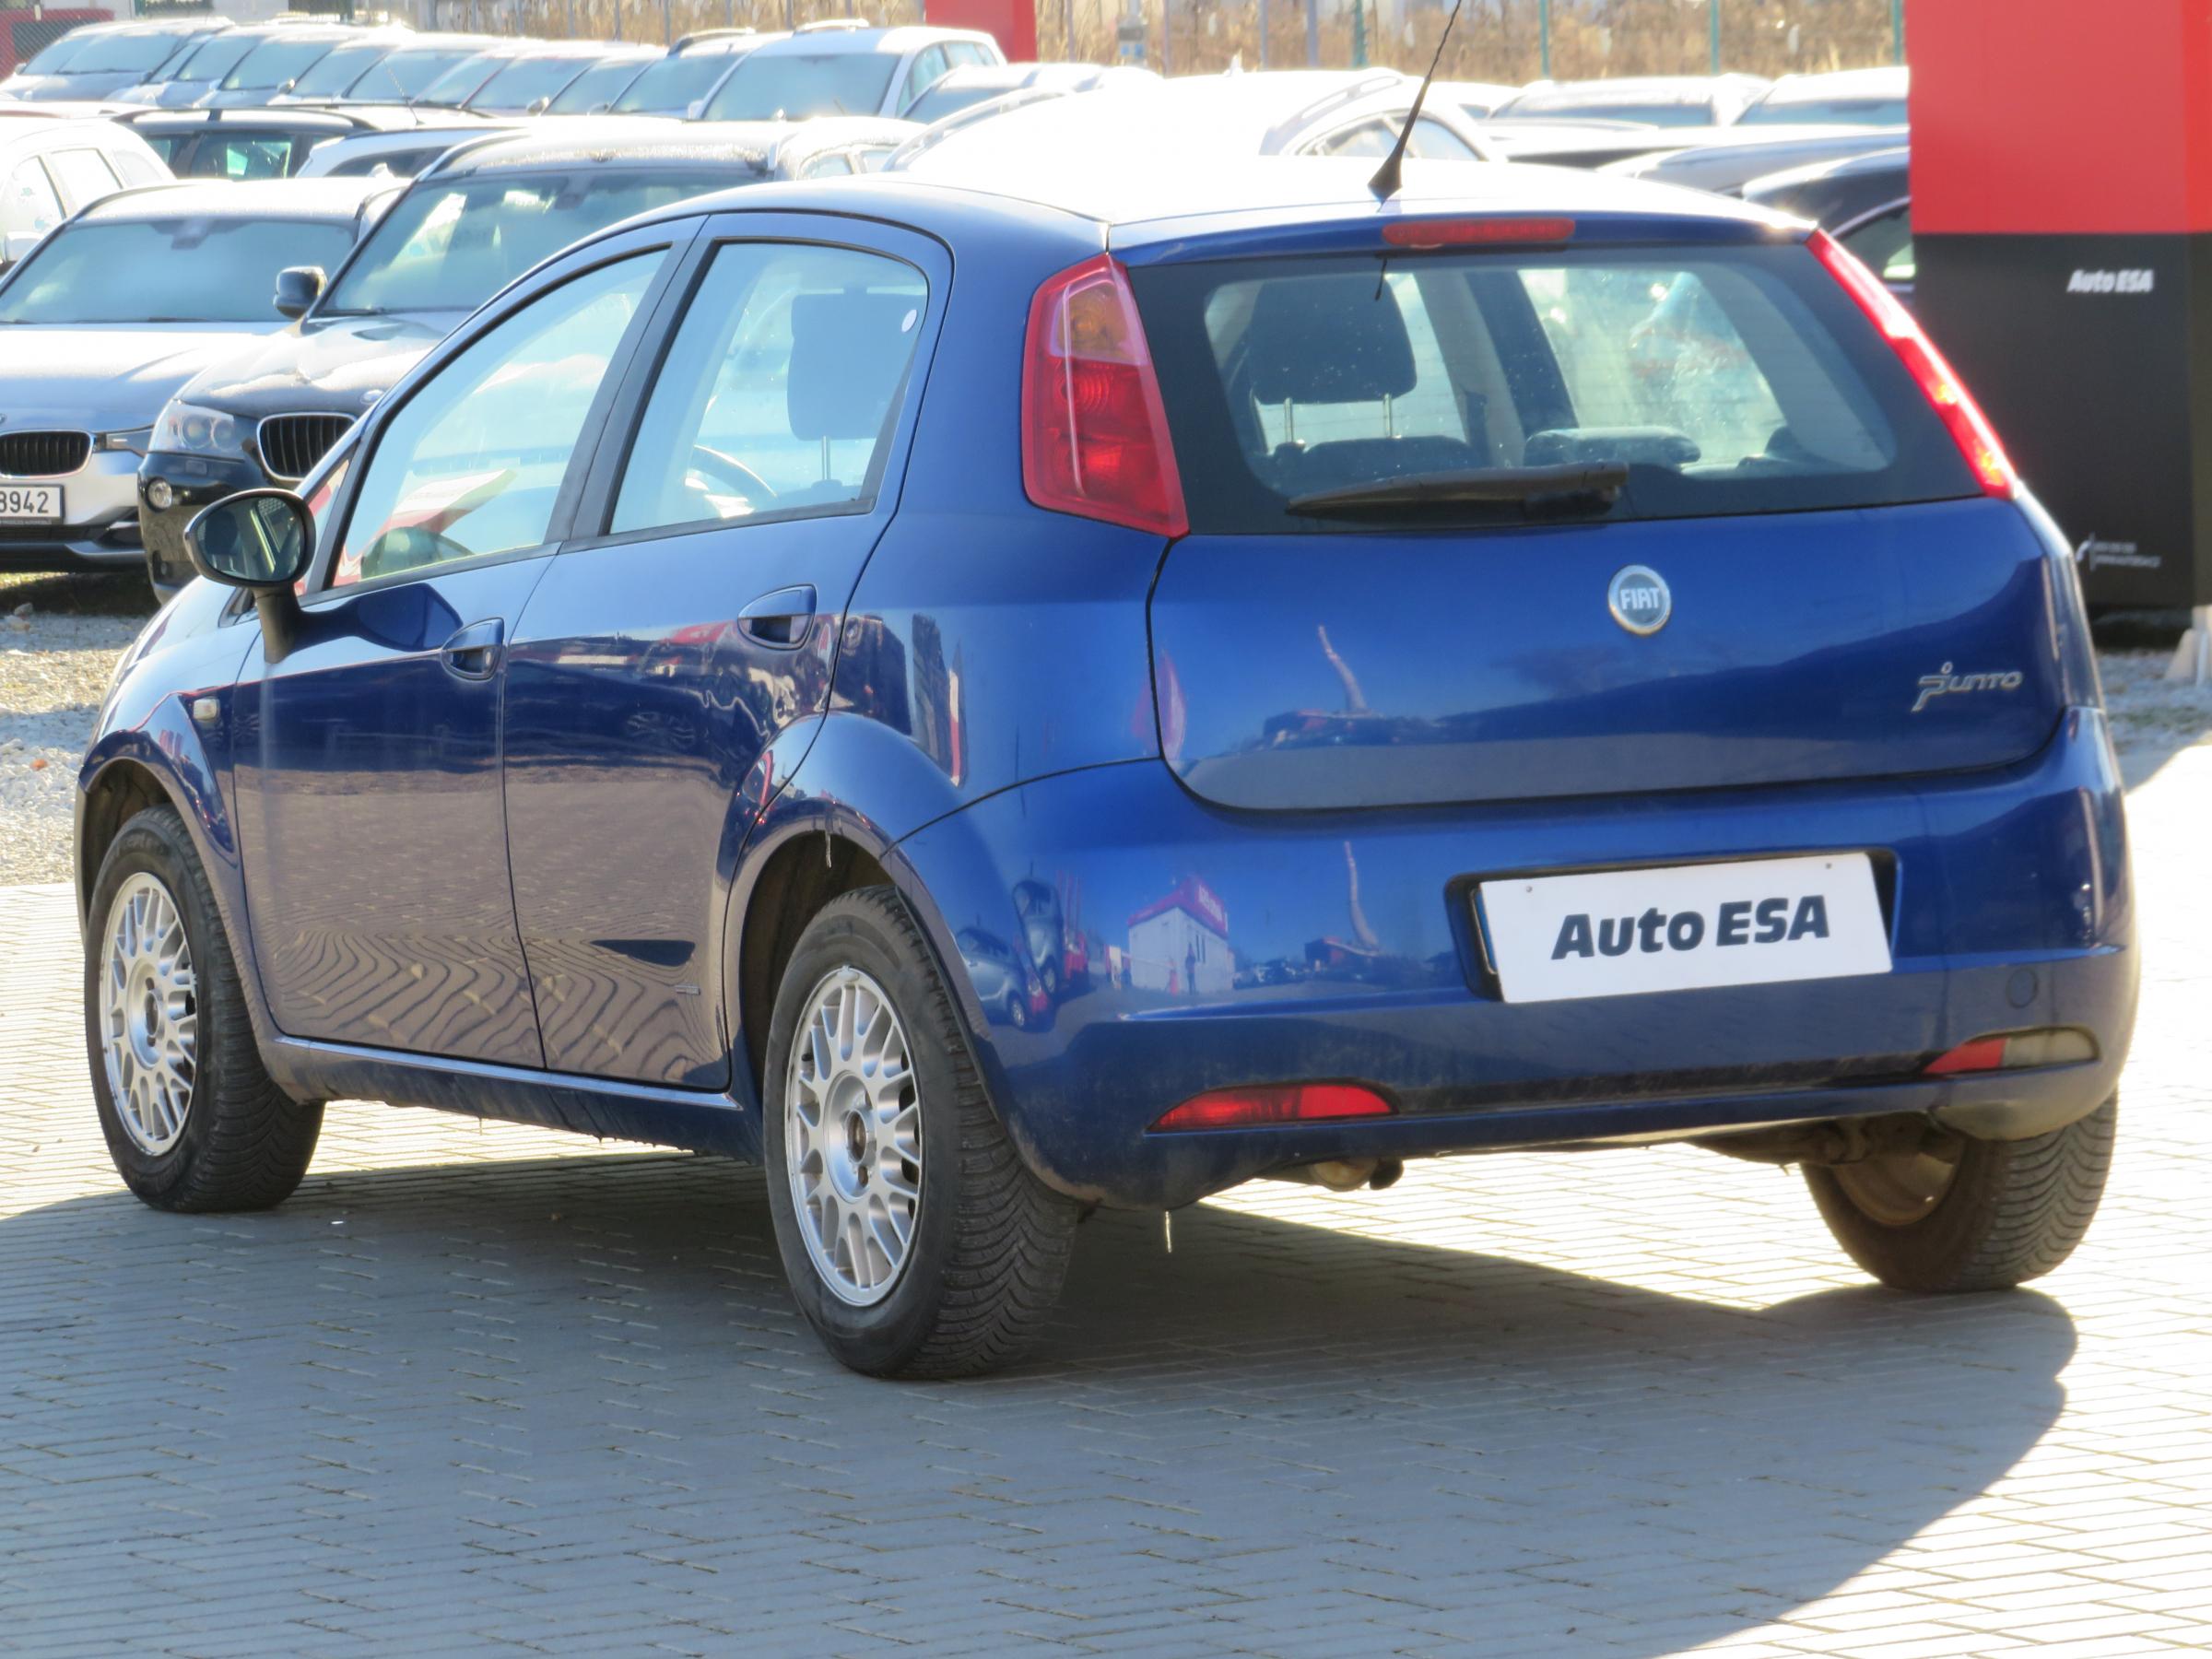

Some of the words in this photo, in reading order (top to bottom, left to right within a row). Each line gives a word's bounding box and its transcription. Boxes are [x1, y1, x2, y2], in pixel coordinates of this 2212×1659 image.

[2065, 268, 2115, 292] Auto
[2115, 268, 2154, 292] ESA
[1620, 587, 1660, 610] FIAT
[1551, 907, 1705, 959] Auto
[1716, 895, 1830, 947] ESA
